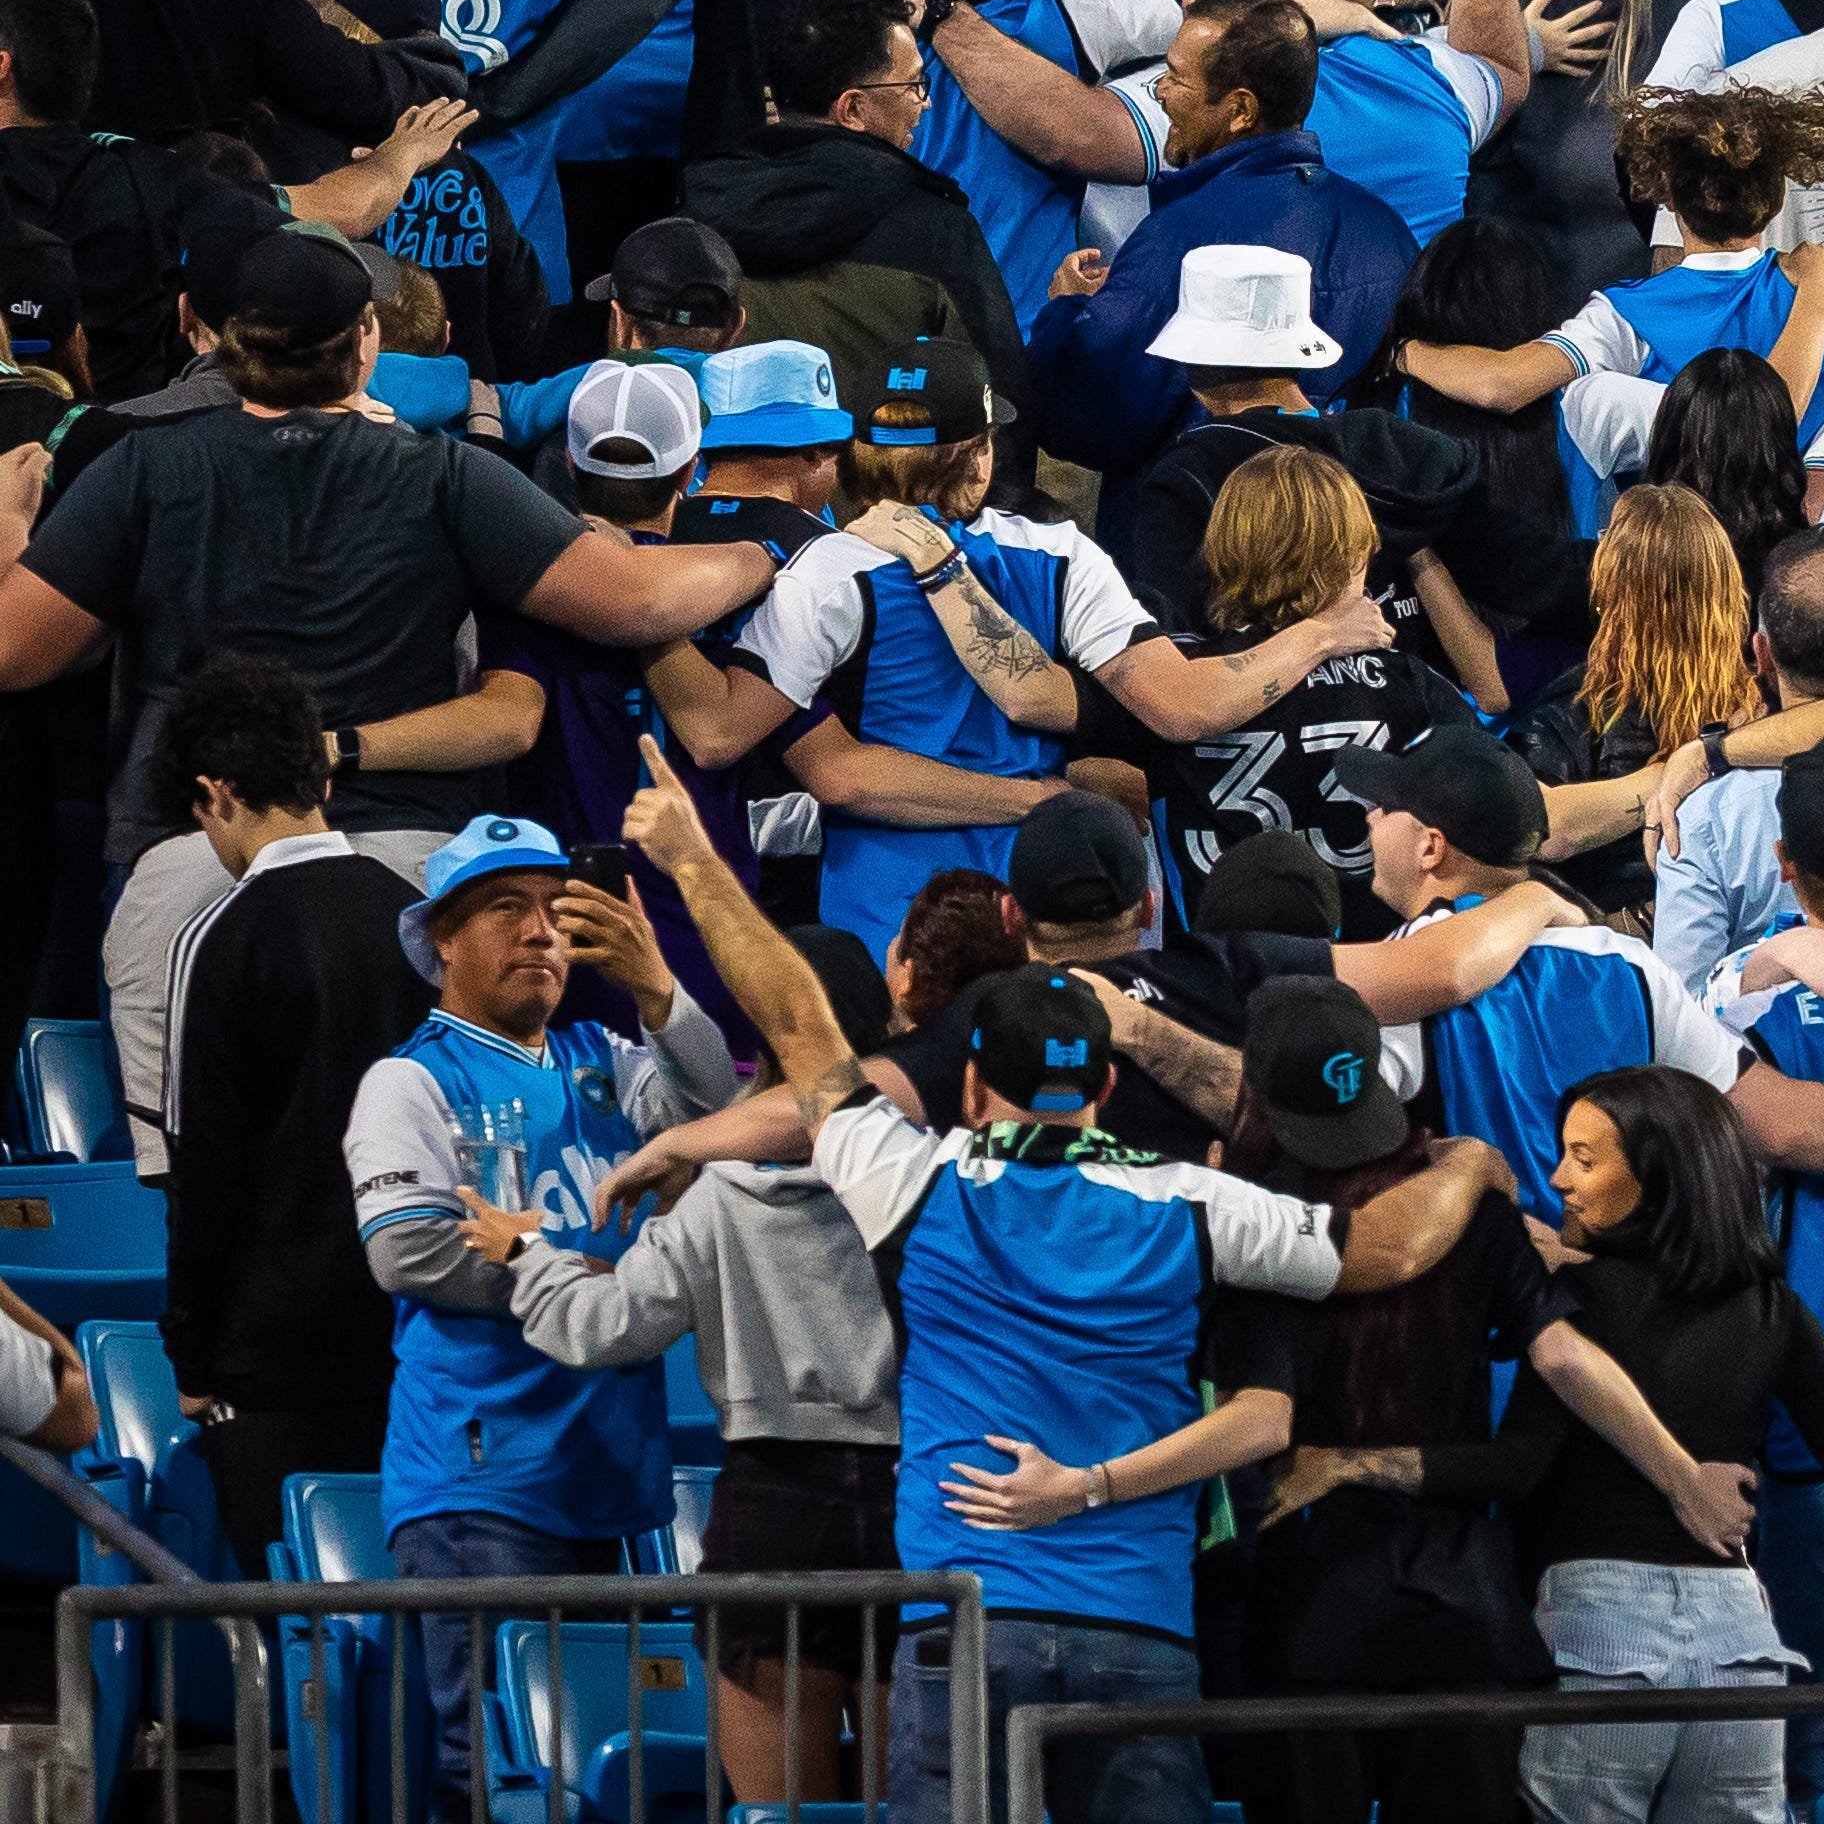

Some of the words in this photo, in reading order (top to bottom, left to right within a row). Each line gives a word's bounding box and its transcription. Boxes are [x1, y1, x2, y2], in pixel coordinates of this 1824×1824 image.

[460, 184, 488, 231] &
[383, 212, 488, 269] Value
[10, 300, 43, 319] ally
